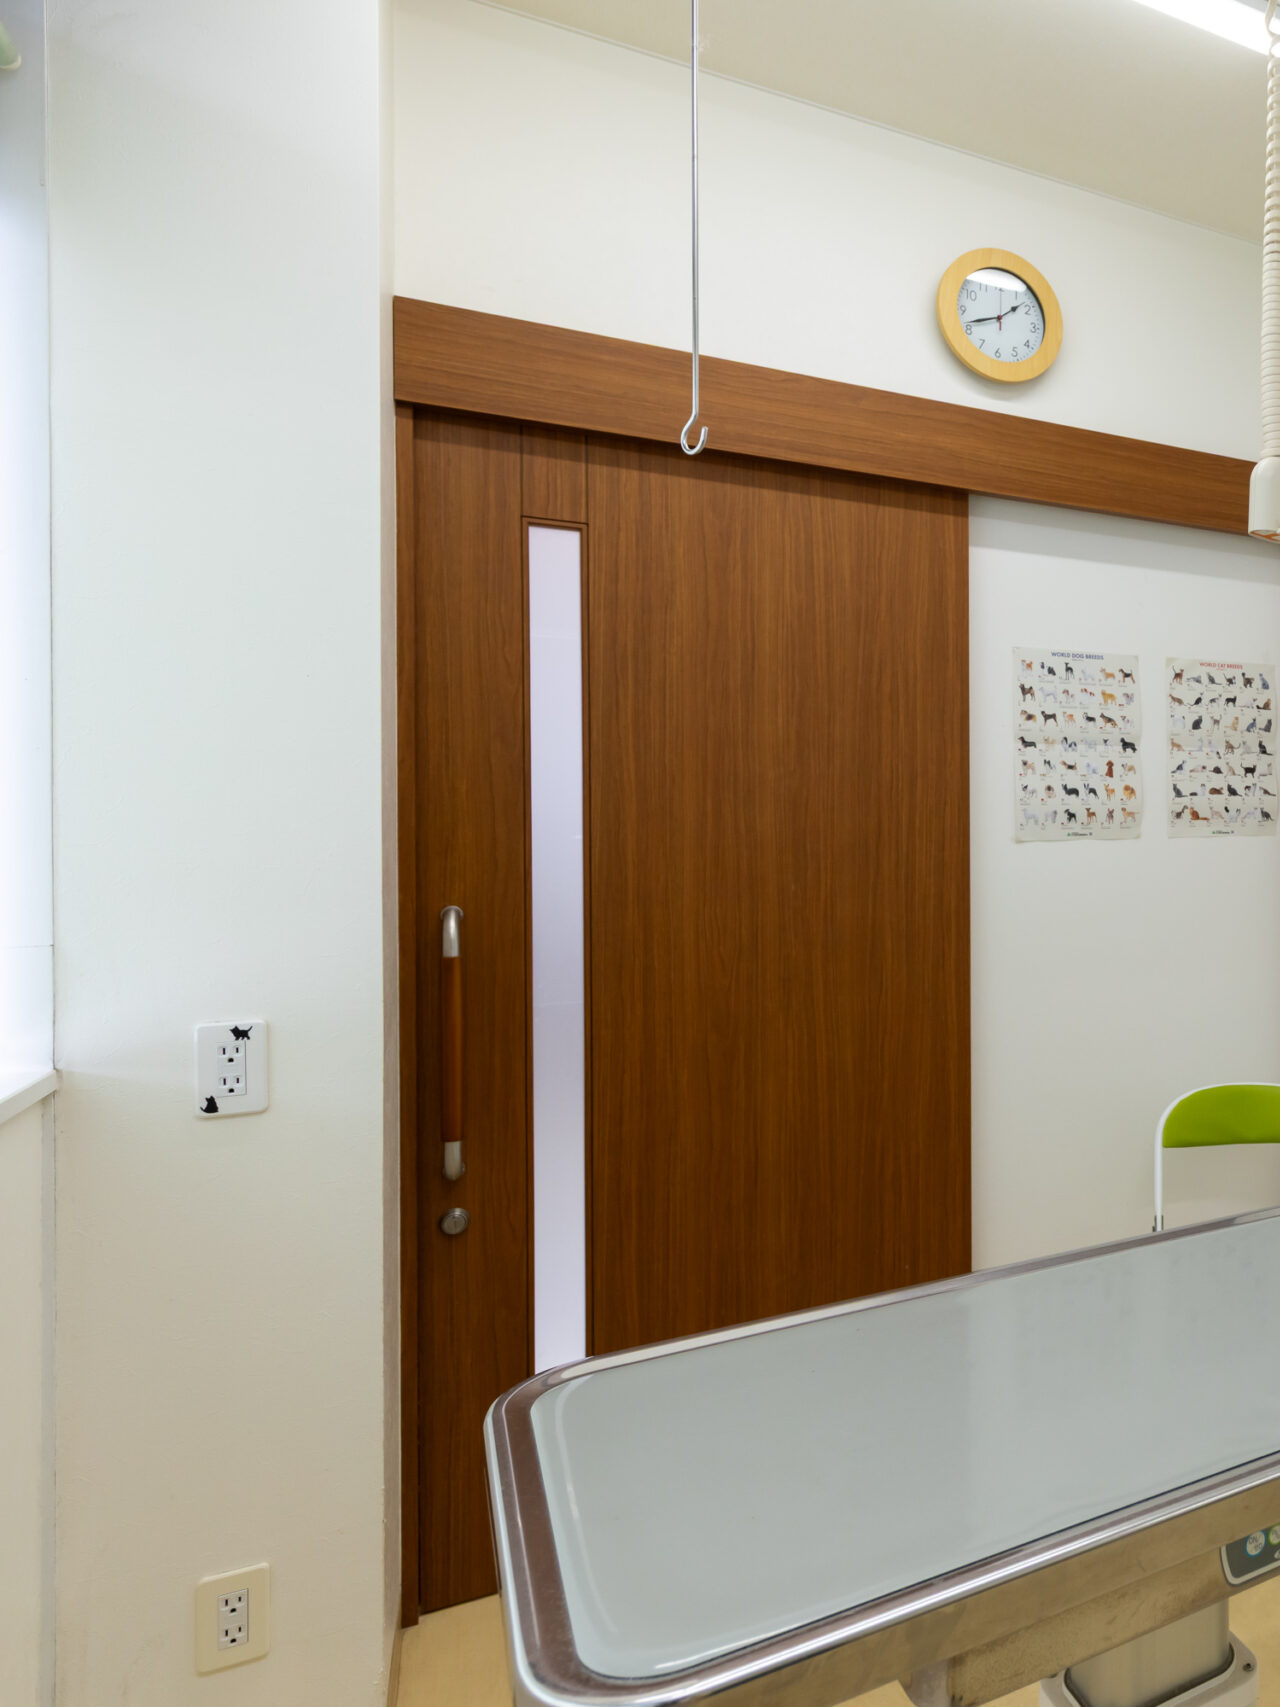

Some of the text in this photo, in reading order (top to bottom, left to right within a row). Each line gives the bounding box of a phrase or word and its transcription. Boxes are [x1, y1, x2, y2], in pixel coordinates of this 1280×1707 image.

[965, 289, 977, 302] 10
[960, 305, 967, 315] 9
[1024, 304, 1031, 315] 2
[965, 324, 972, 336] 8
[1030, 322, 1037, 333] 3
[979, 338, 985, 349] 7
[1023, 339, 1030, 349] 4
[994, 348, 1001, 358] 6
[1011, 346, 1018, 358] 5
